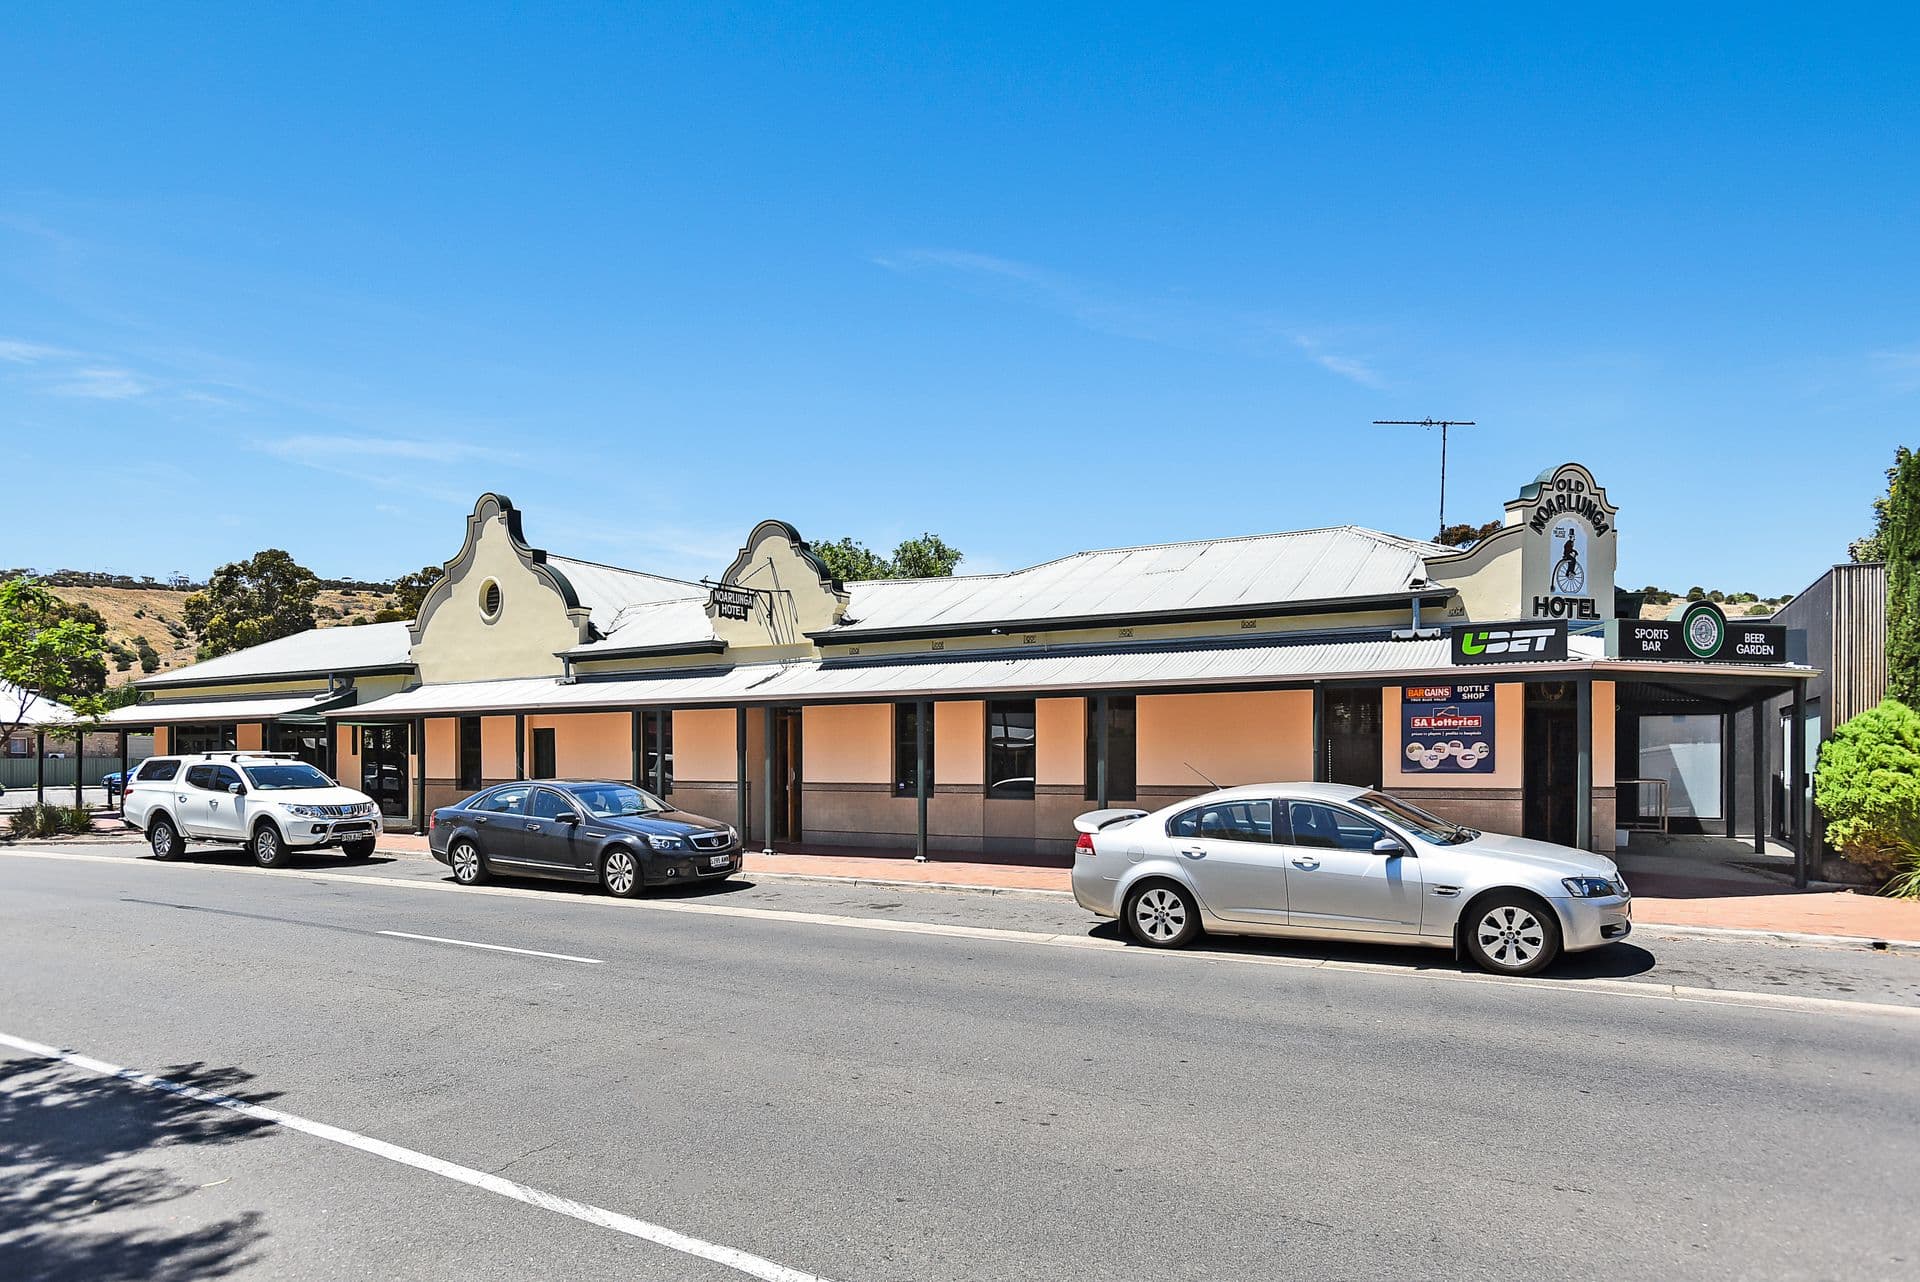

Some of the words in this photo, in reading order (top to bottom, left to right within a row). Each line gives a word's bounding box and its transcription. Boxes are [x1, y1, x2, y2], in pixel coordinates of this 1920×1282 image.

[1555, 478, 1585, 494] OLD
[1529, 494, 1610, 537] NOARLUNGA
[714, 590, 753, 607] NOARLUNGA
[721, 604, 745, 616] HOTEL
[1533, 596, 1600, 620] HOTEL
[1634, 628, 1669, 641] SPORTS
[1744, 632, 1765, 644] BEER
[1461, 628, 1556, 655] UBET
[1642, 640, 1661, 652] BAR
[1736, 643, 1774, 656] GARDEN
[1407, 688, 1450, 697] BARGAINS
[1461, 692, 1485, 700] SHOP
[1413, 718, 1428, 727] SA
[1431, 717, 1479, 727] Lotteries
